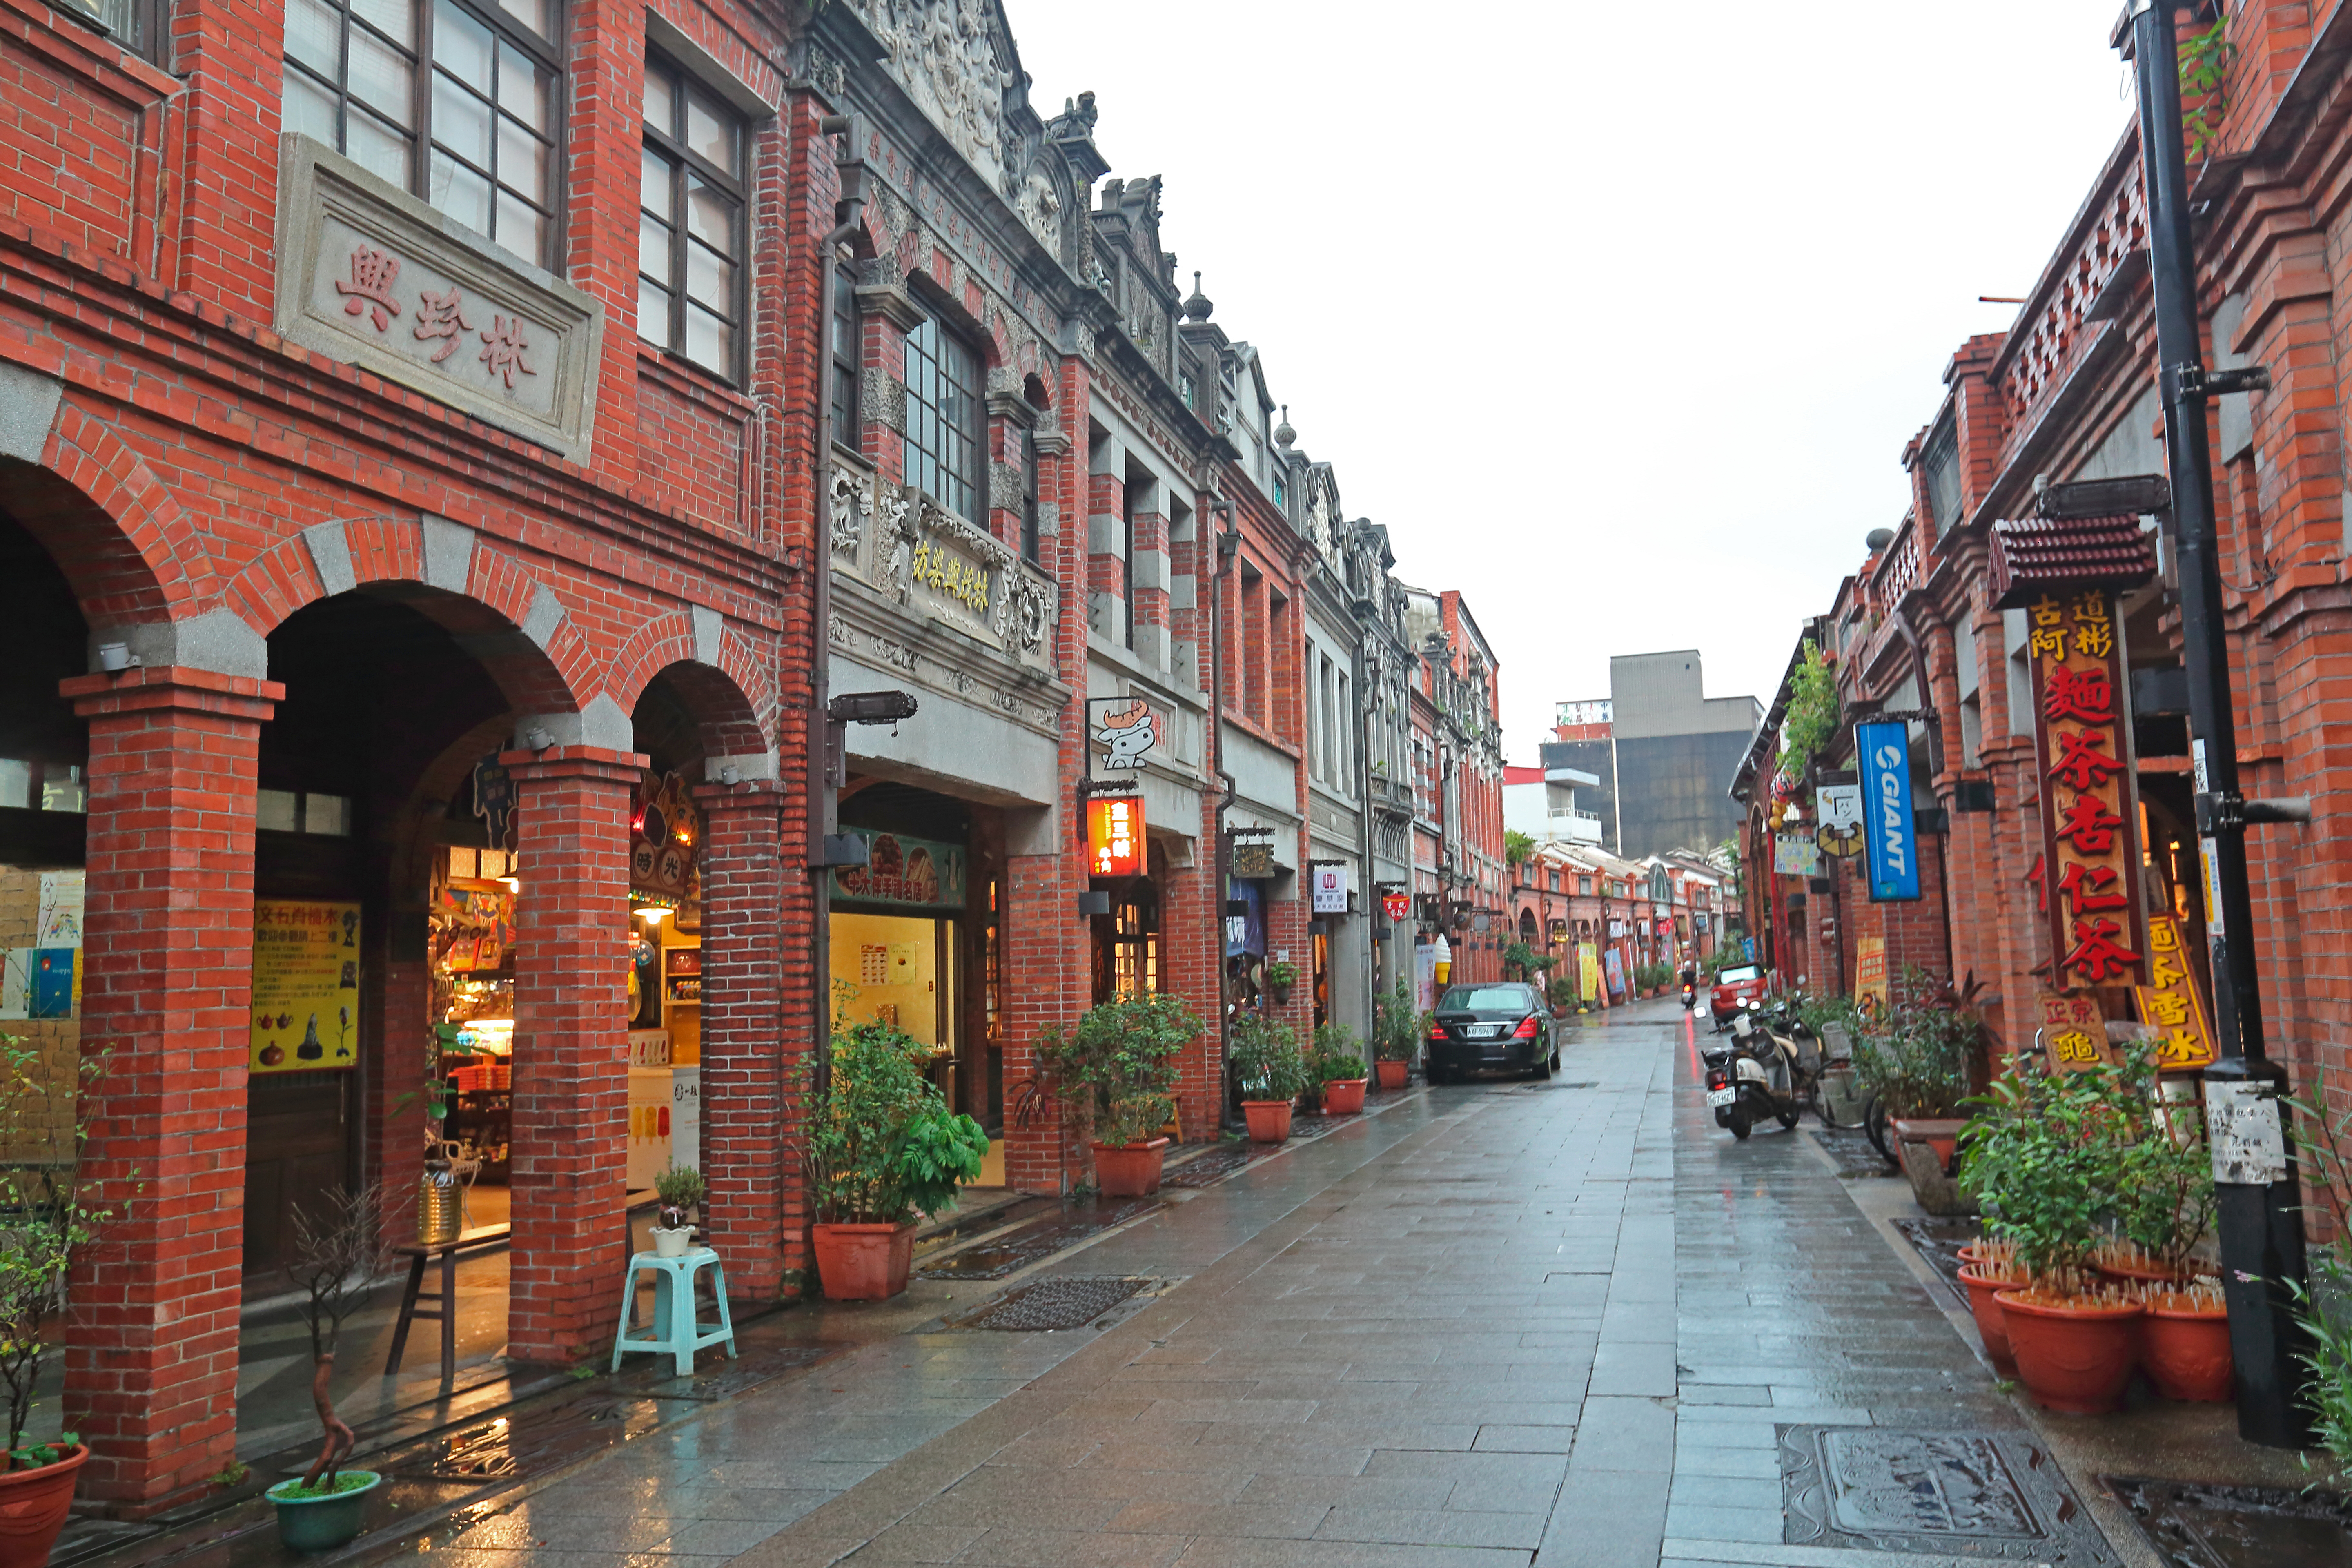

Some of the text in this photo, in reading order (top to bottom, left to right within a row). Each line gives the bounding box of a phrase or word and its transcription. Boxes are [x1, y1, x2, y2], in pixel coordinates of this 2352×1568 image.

[335, 243, 537, 389] 林珍興
[913, 540, 989, 612] 林茂興染坊
[2030, 590, 2109, 627] 古道
[2031, 622, 2113, 662] 阿彬
[1881, 771, 1906, 877] GIANT
[2044, 666, 2143, 981] 麵茶杏仁茶
[636, 852, 678, 879] 時光
[2045, 999, 2094, 1024] 正宗
